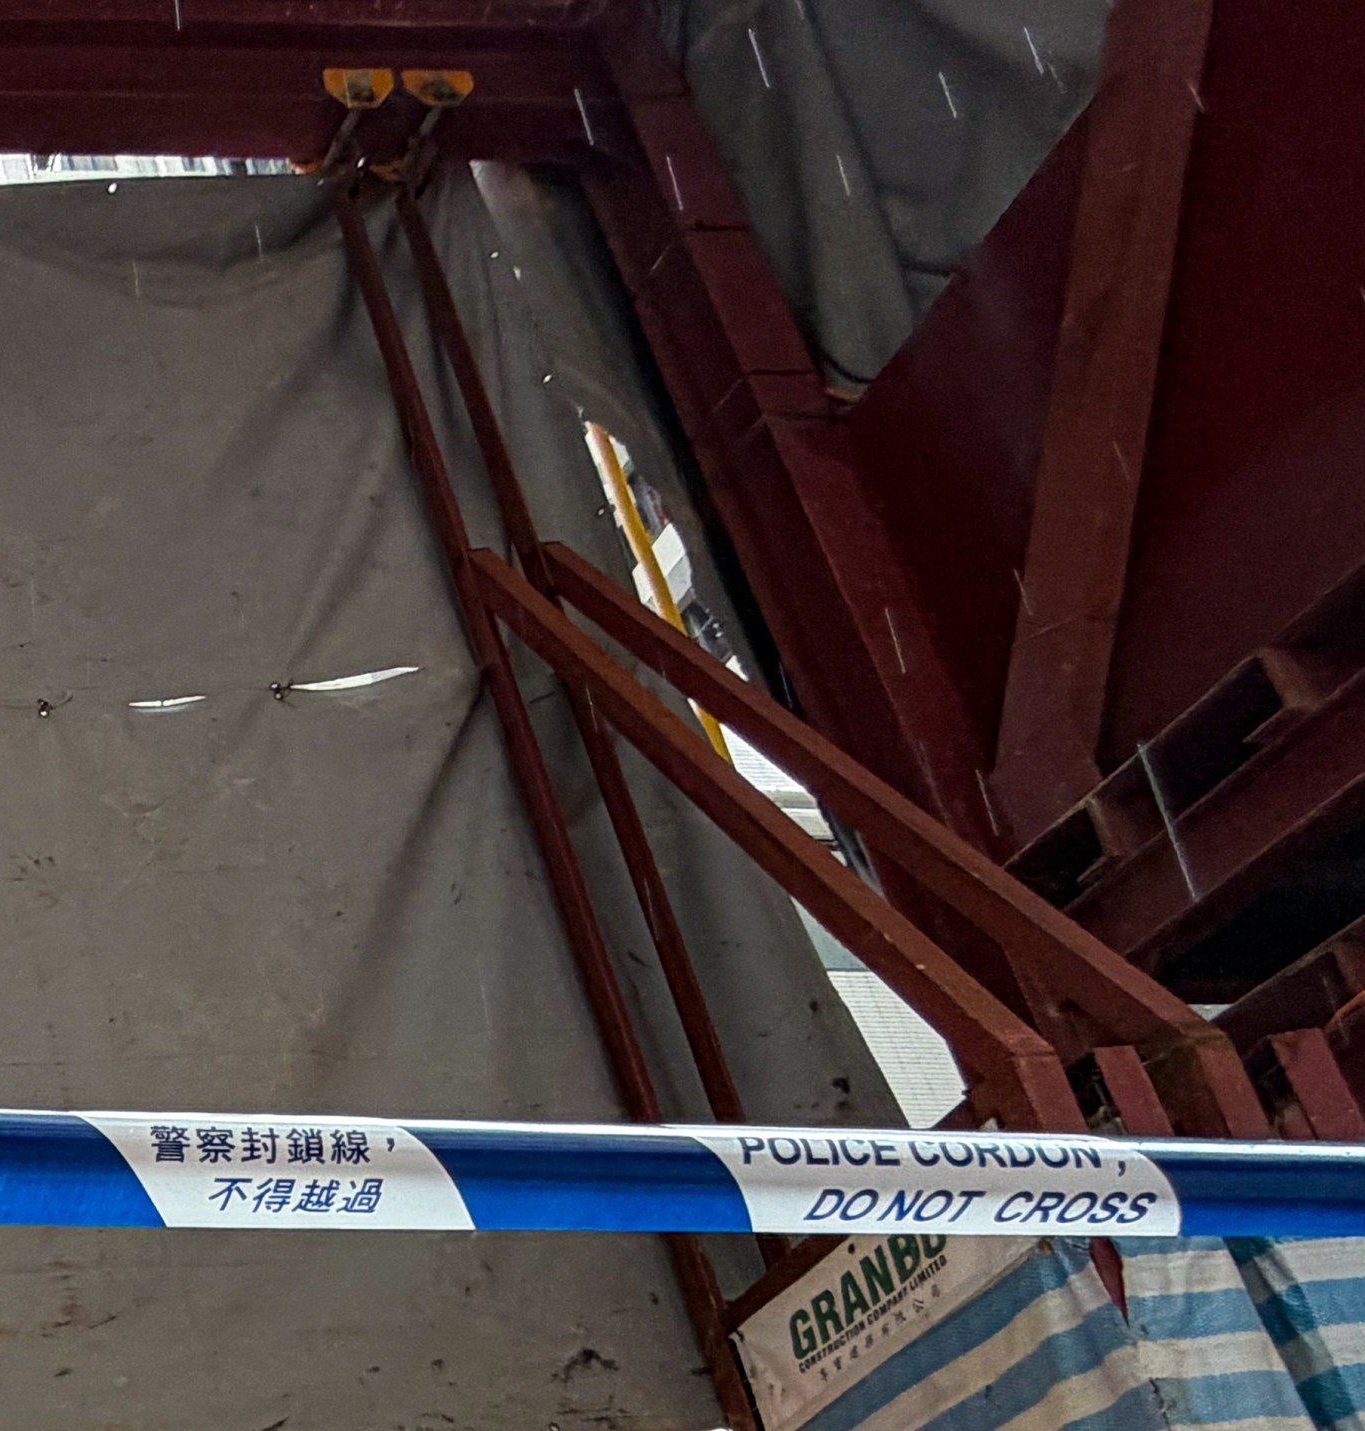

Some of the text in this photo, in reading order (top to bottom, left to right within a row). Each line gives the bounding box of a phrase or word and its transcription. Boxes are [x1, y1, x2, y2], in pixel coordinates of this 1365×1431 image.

[738, 1136, 899, 1166] POLICE
[208, 1178, 383, 1214] 不得越過
[804, 1189, 1157, 1224] DO NOT CROSS
[799, 1254, 947, 1374] CONSTRUCTION COMPANY LIMITED
